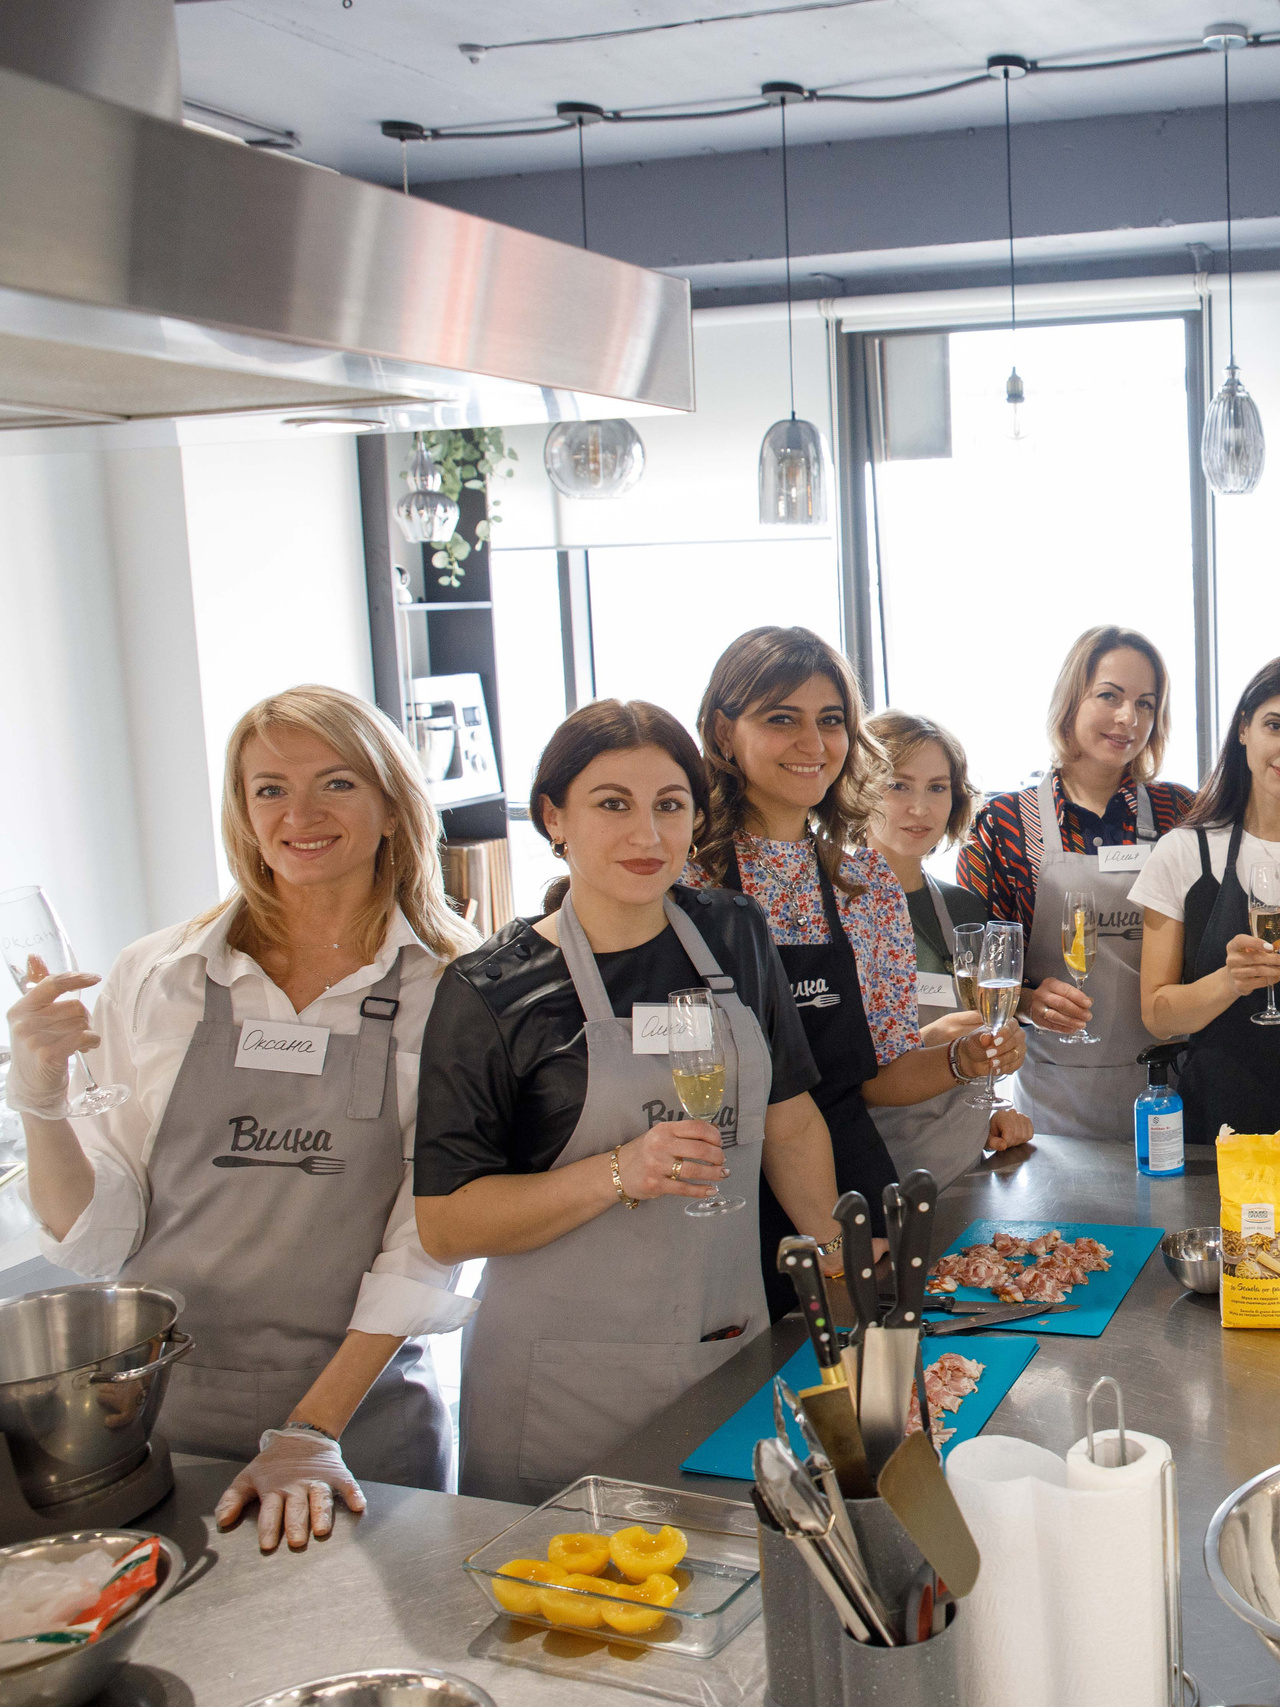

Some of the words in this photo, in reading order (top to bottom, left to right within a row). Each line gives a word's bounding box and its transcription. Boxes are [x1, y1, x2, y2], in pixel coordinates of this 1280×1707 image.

[790, 978, 829, 998] лка
[242, 1029, 316, 1053] Оксана
[228, 1115, 333, 1154] Вилка
